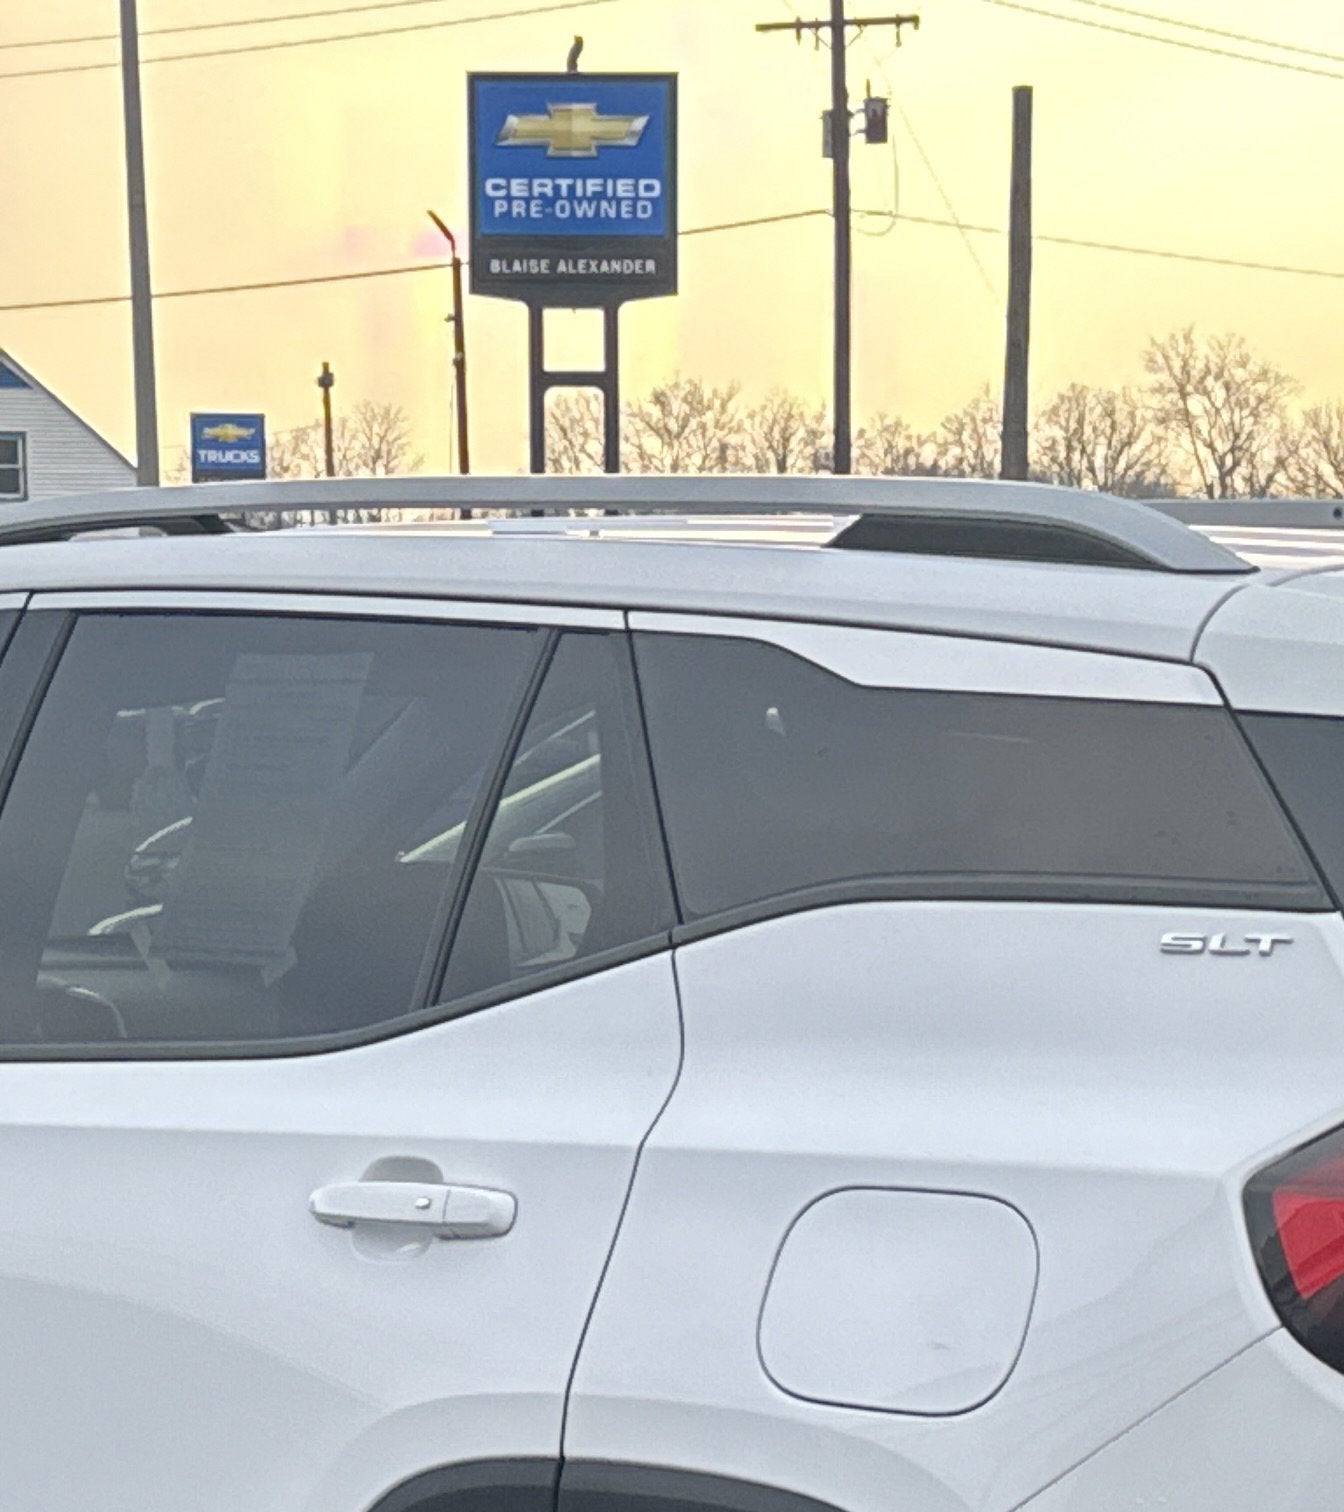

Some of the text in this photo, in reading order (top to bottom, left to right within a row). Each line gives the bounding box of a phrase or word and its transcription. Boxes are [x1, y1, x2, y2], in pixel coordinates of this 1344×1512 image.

[484, 177, 662, 198] CERTIFIED
[493, 199, 653, 219] PRE-OWNED
[489, 259, 656, 274] BLAISE ALEXANDER
[197, 449, 260, 464] TRUCKS
[1159, 932, 1294, 957] SLT
